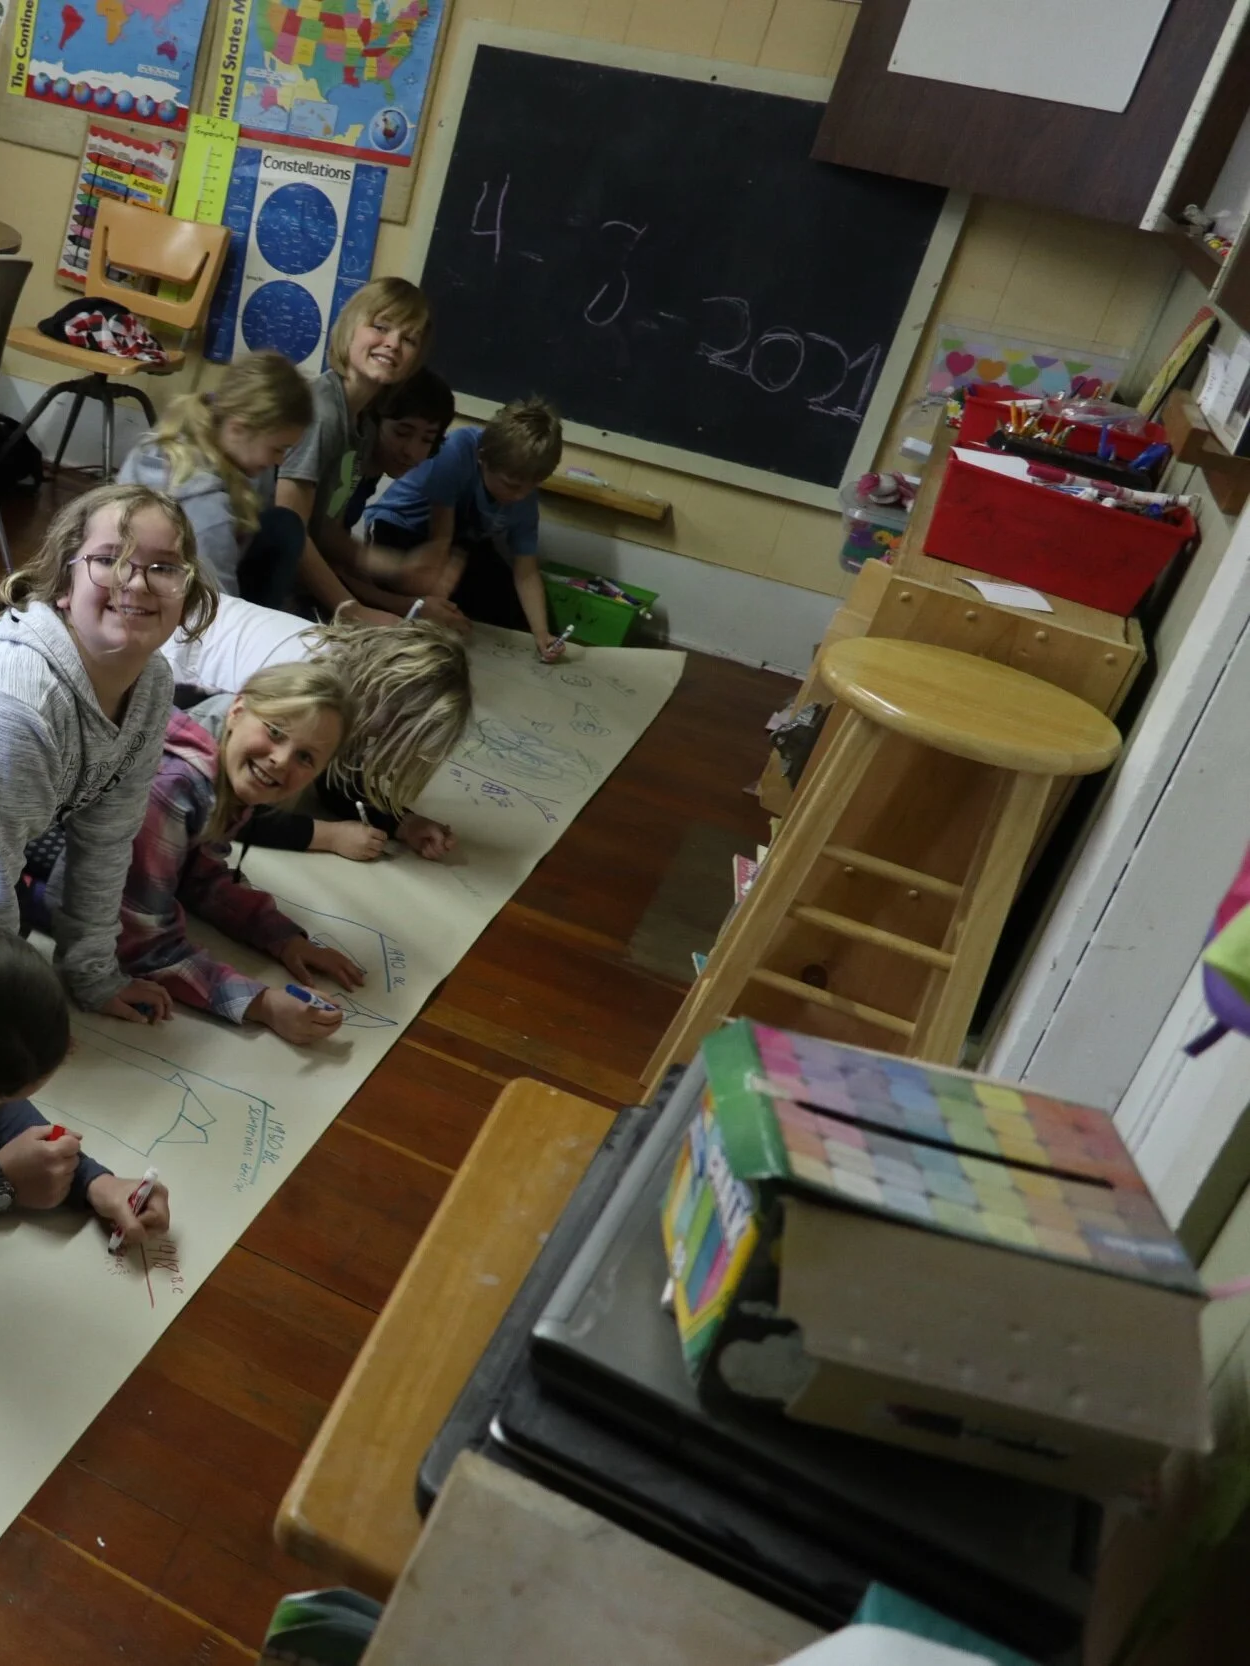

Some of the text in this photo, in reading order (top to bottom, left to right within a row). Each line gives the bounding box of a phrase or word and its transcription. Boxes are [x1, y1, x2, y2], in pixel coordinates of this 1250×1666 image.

[222, 18, 243, 71] States
[11, 63, 26, 88] The
[216, 73, 234, 119] nited
[263, 155, 352, 181] Constellations
[694, 295, 882, 424] 2021
